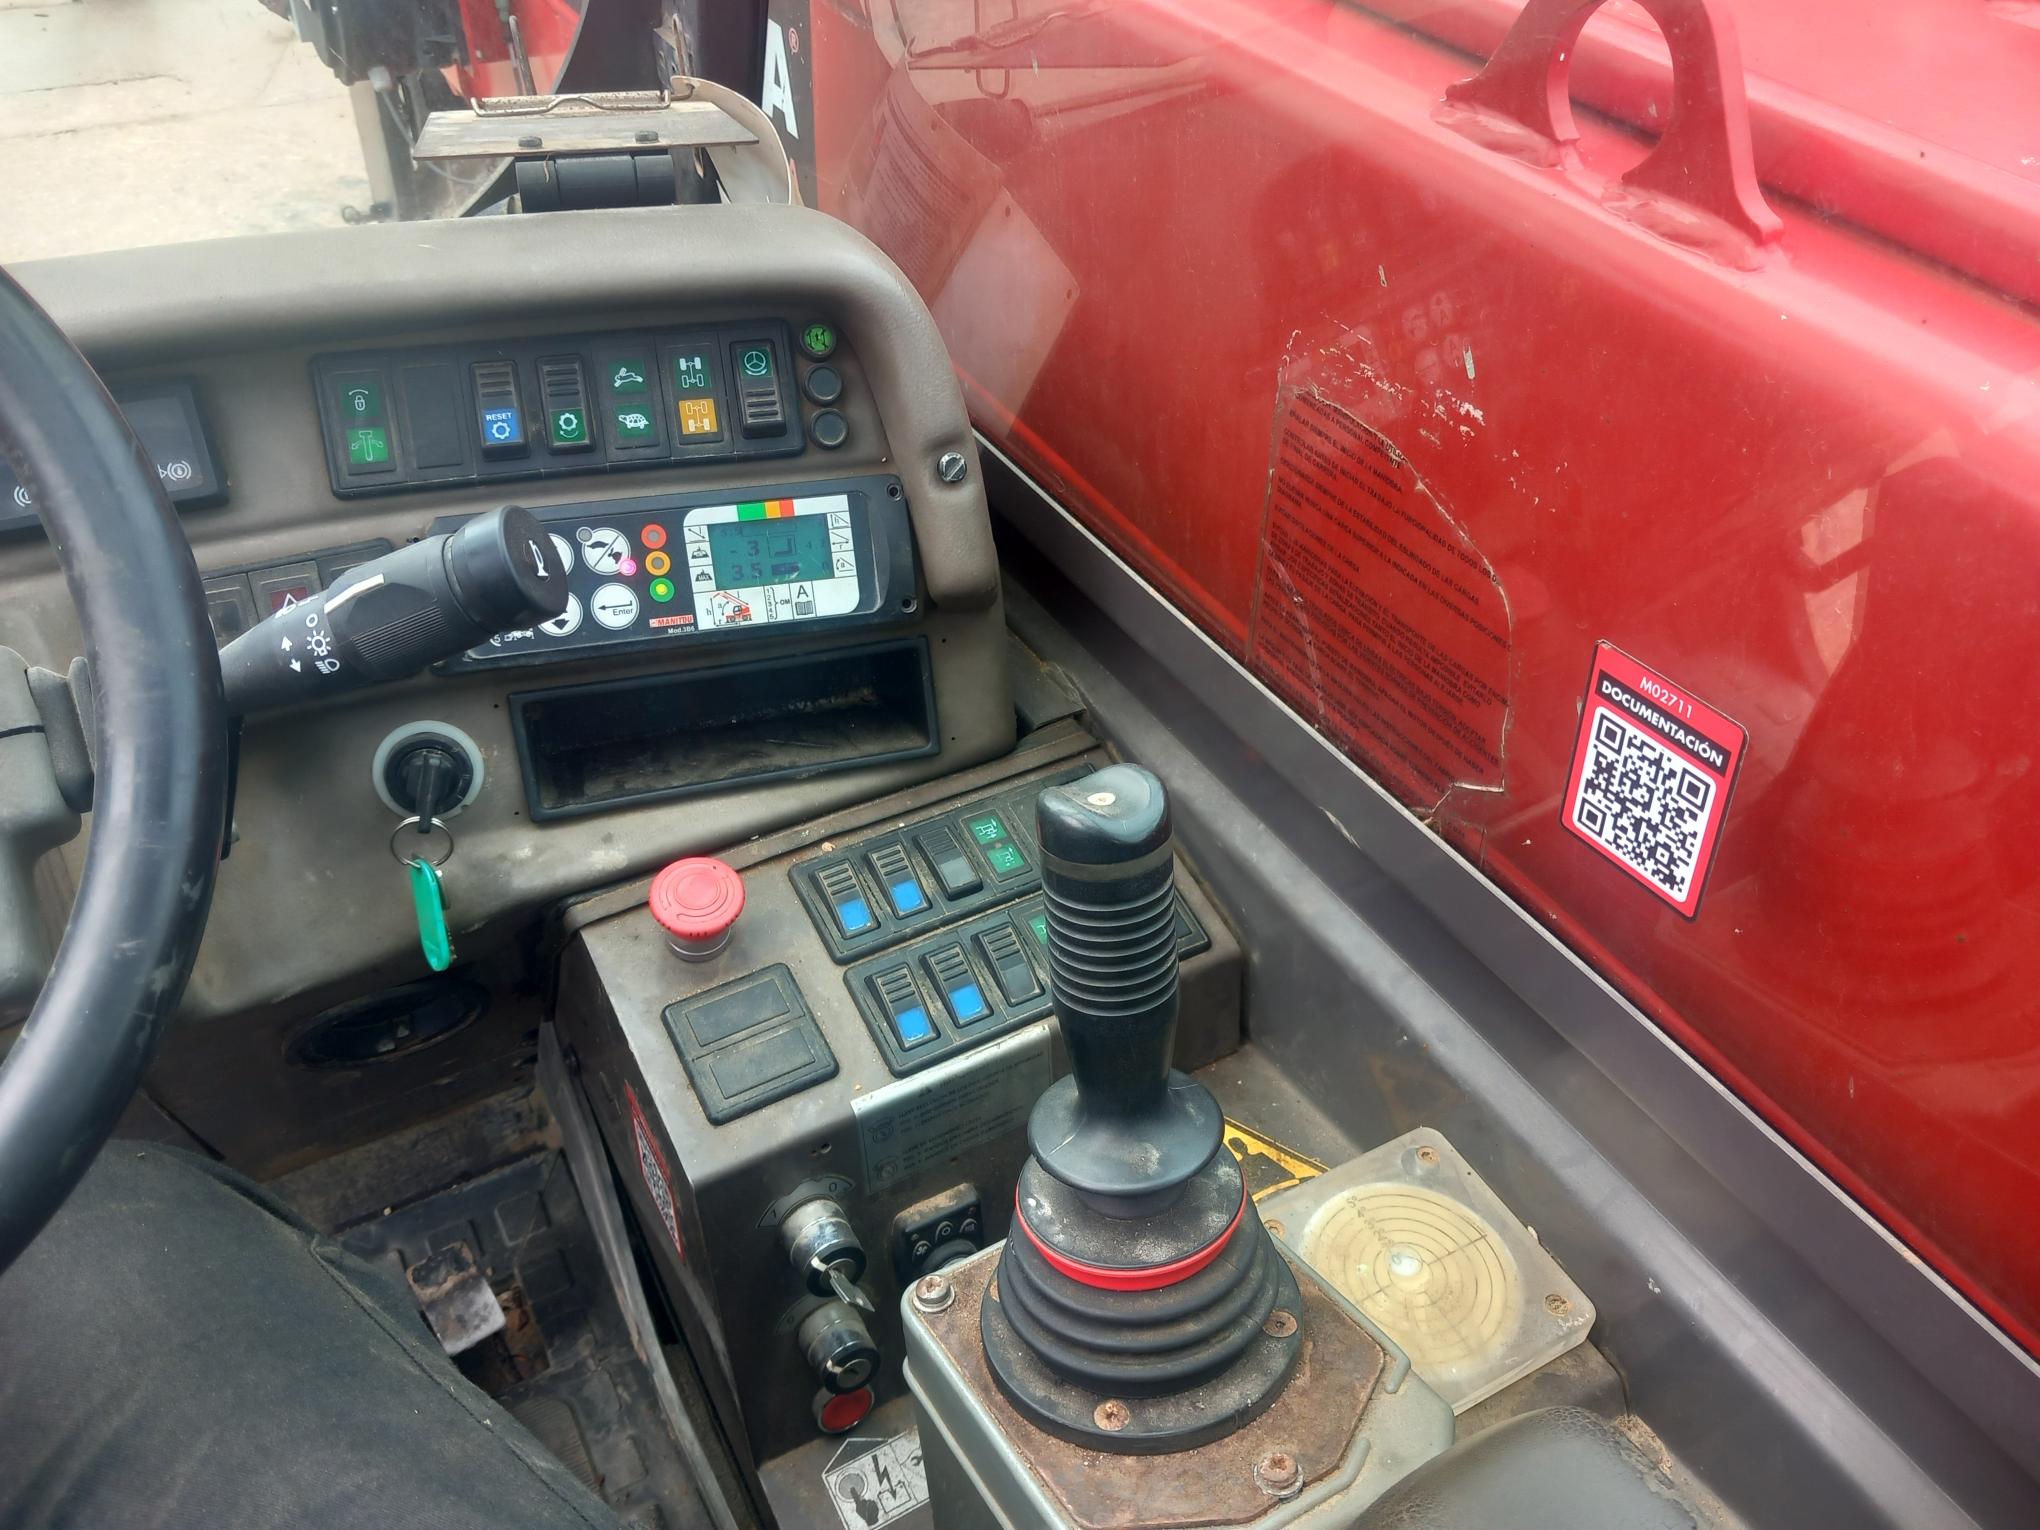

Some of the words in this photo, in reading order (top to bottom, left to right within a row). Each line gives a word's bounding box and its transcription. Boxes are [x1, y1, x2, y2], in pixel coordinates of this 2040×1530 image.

[762, 18, 799, 140] A
[485, 412, 512, 421] RESET
[796, 585, 809, 599] A
[612, 608, 634, 617] Enter
[657, 614, 694, 627] MANITOU
[1640, 677, 1693, 718] M02711
[1601, 680, 1722, 767] DOCUMENTACIÓN
